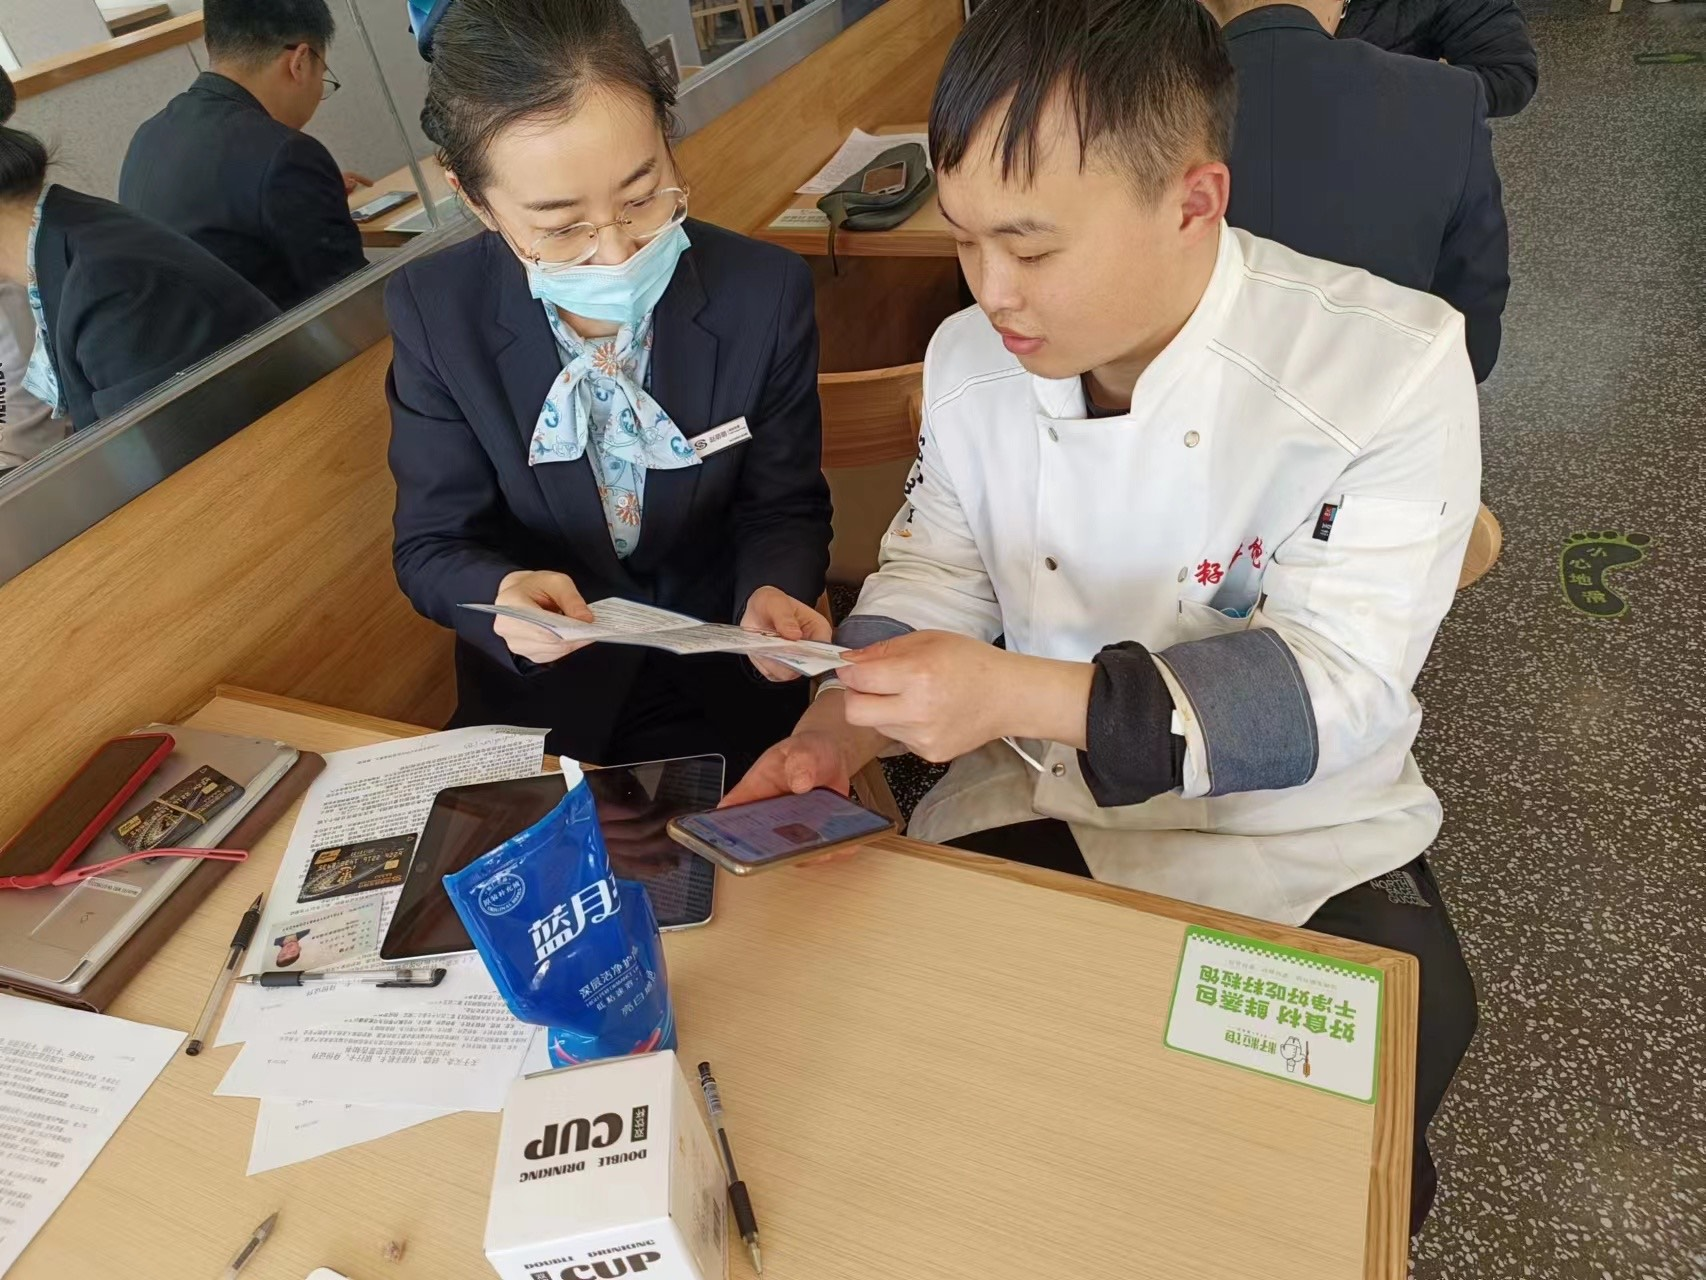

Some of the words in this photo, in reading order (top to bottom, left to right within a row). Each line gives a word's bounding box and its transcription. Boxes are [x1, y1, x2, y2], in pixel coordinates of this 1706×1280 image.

[527, 872, 621, 963] 蓝月
[1195, 983, 1270, 1020] 鲜蒸包
[1199, 964, 1357, 1020] 干净好吃籽粒饱
[1276, 1005, 1355, 1043] 好食材
[523, 1112, 624, 1160] CUP
[518, 1161, 585, 1183] DRINKING
[597, 1148, 647, 1168] DOUBLE
[524, 1255, 575, 1270] DOUBLE
[587, 1239, 656, 1258] DRINKING
[560, 1251, 662, 1280] CUP
